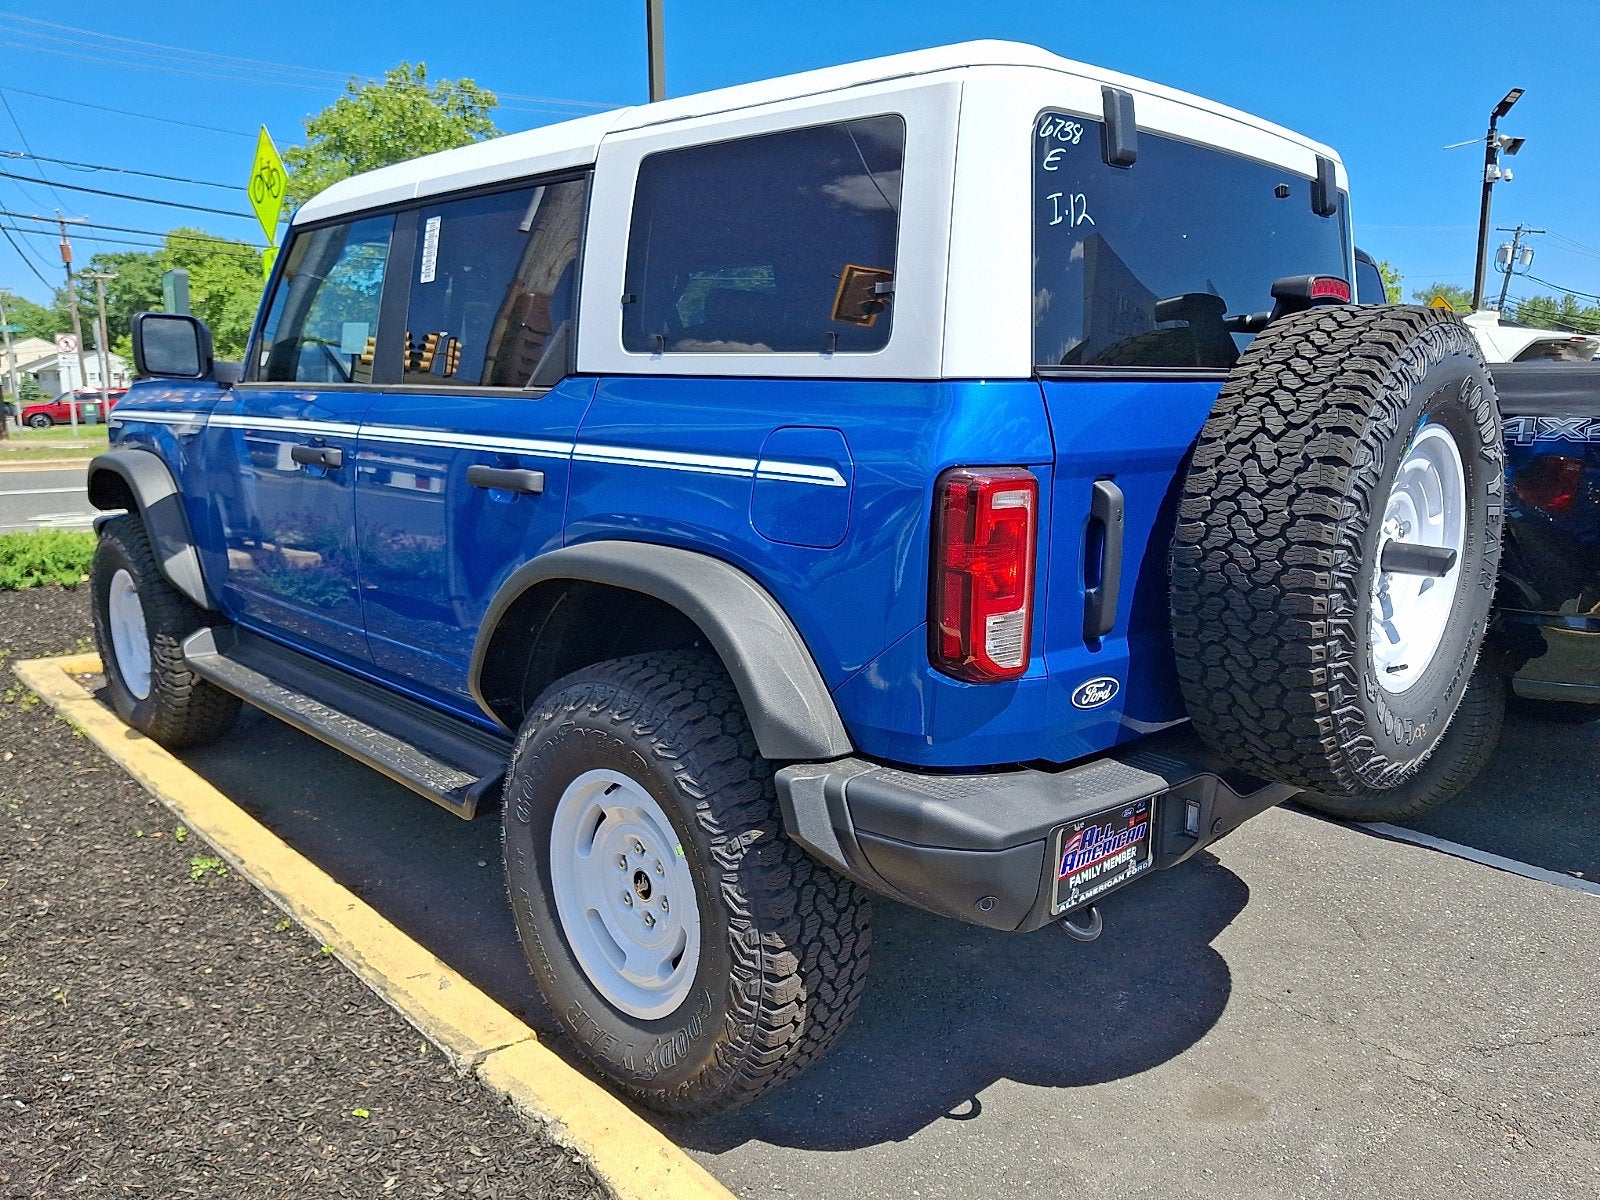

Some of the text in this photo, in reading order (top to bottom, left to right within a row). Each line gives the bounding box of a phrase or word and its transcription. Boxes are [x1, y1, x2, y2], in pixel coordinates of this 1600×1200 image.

[1039, 116, 1084, 145] 6738
[1043, 148, 1067, 171] E
[1080, 681, 1113, 705] Ford
[1059, 822, 1148, 877] AMERICAN
[1069, 846, 1137, 889] FAMILY MEMBER
[1079, 875, 1125, 903] AMERICAN
[1126, 863, 1149, 879] FORD
